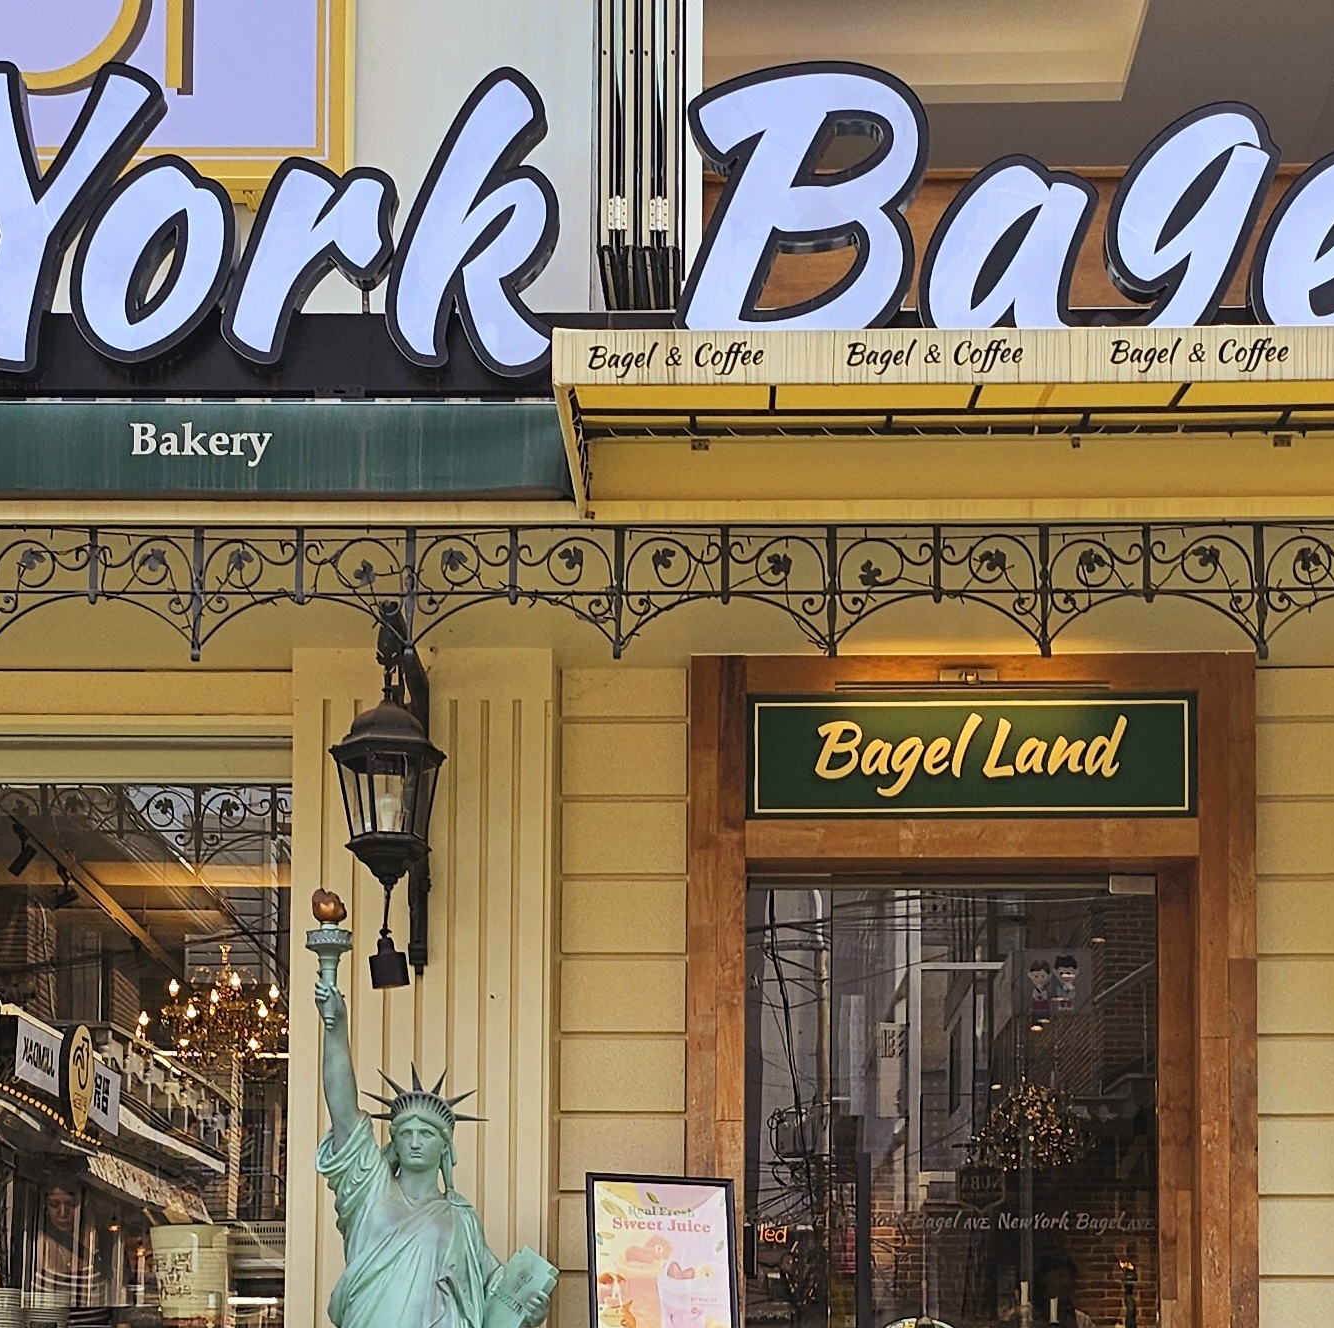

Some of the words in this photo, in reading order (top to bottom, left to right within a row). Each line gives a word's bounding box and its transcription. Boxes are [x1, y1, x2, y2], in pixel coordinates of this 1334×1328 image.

[587, 342, 657, 378] Bagel
[665, 346, 683, 368] &
[693, 341, 765, 376] Coffee
[845, 338, 919, 376] Bagel
[923, 344, 942, 365] &
[952, 338, 1024, 374] Coffee
[1109, 336, 1184, 373] Bagel
[1188, 341, 1206, 363] &
[1217, 336, 1290, 373] Coffee
[130, 420, 273, 466] Bakery
[813, 711, 983, 798] Bagel
[982, 714, 1128, 779] Land
[612, 1216, 664, 1231] Sweet
[667, 1219, 711, 1233] Juice
[998, 1211, 1069, 1231] NewYork
[1075, 1211, 1126, 1236] Bagel
